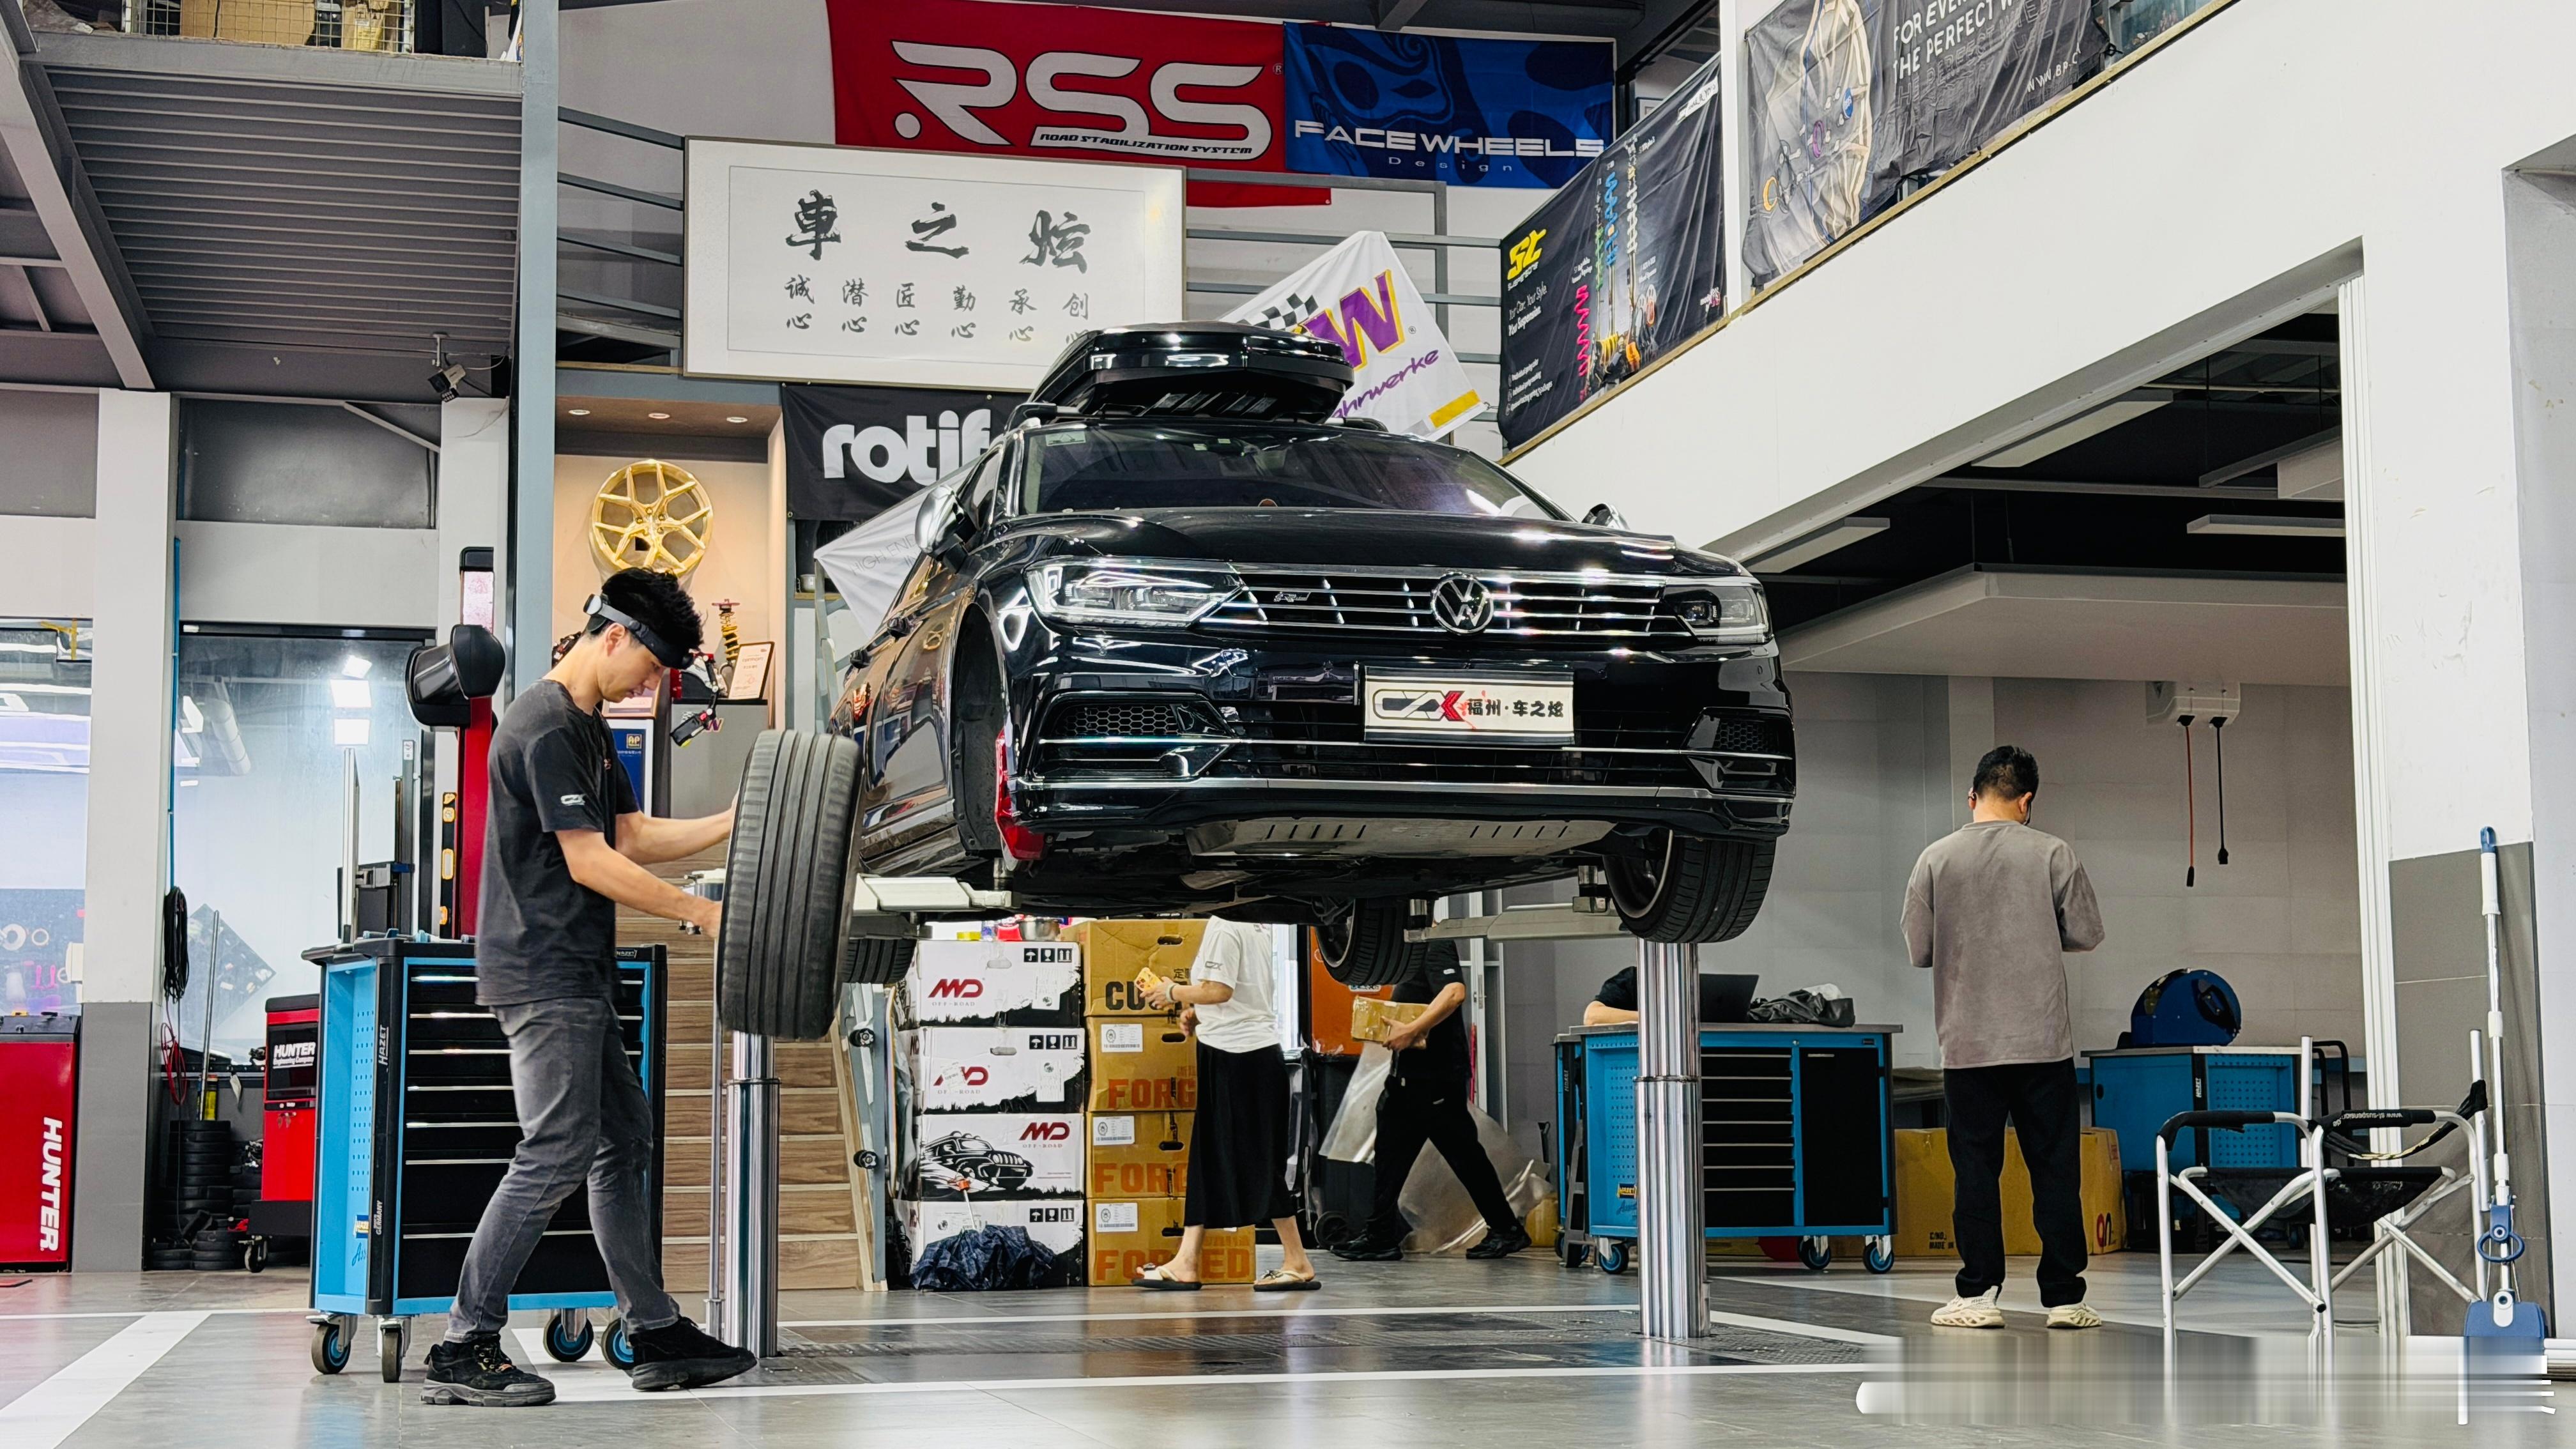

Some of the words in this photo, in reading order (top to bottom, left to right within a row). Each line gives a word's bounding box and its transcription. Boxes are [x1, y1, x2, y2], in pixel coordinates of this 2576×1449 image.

[1893, 12, 1922, 52] FOR
[1926, 0, 1967, 27] EVE
[1893, 46, 1921, 84] THE
[1926, 0, 1994, 63] PERFECT
[1040, 133, 1078, 142] ROAD
[1080, 135, 1189, 151] STABILIZATION
[1192, 146, 1252, 155] SYSTEM
[1388, 157, 1512, 172] Design
[1293, 269, 1405, 372] W
[1331, 349, 1439, 419] ahrwerke
[273, 1042, 316, 1059] HUNTER
[378, 1024, 389, 1066] HAZET
[1108, 1078, 1196, 1108] FORG
[40, 1117, 63, 1251] HUNTER
